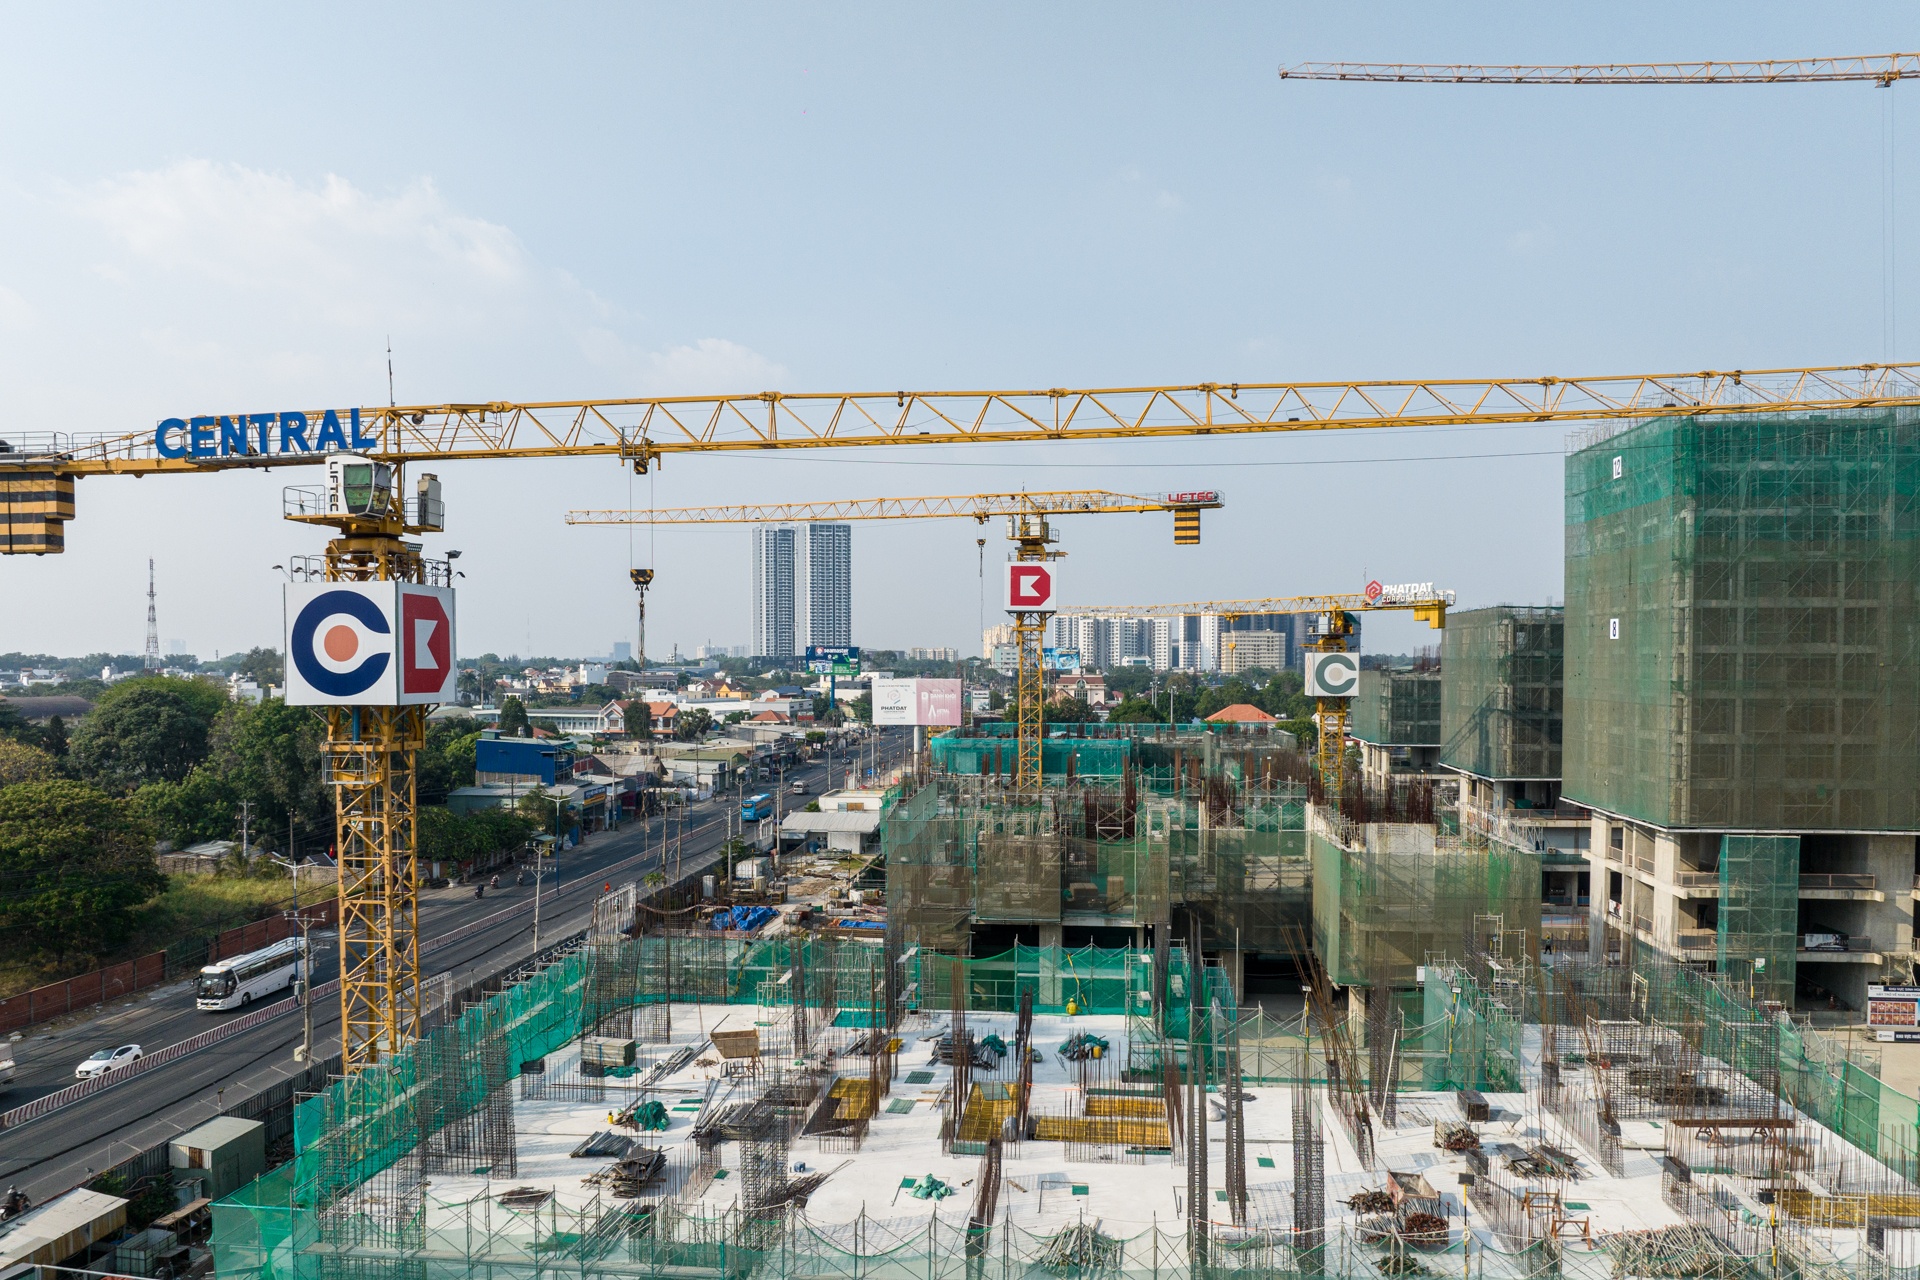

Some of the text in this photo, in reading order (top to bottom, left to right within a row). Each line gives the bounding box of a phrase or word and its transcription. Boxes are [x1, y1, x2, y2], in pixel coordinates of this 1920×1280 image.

[155, 407, 377, 459] CENTRAL
[1614, 458, 1621, 476] 12
[329, 461, 339, 512] LIFTEC
[1168, 491, 1214, 502] LIFTEC
[1382, 582, 1433, 594] PHATDAT
